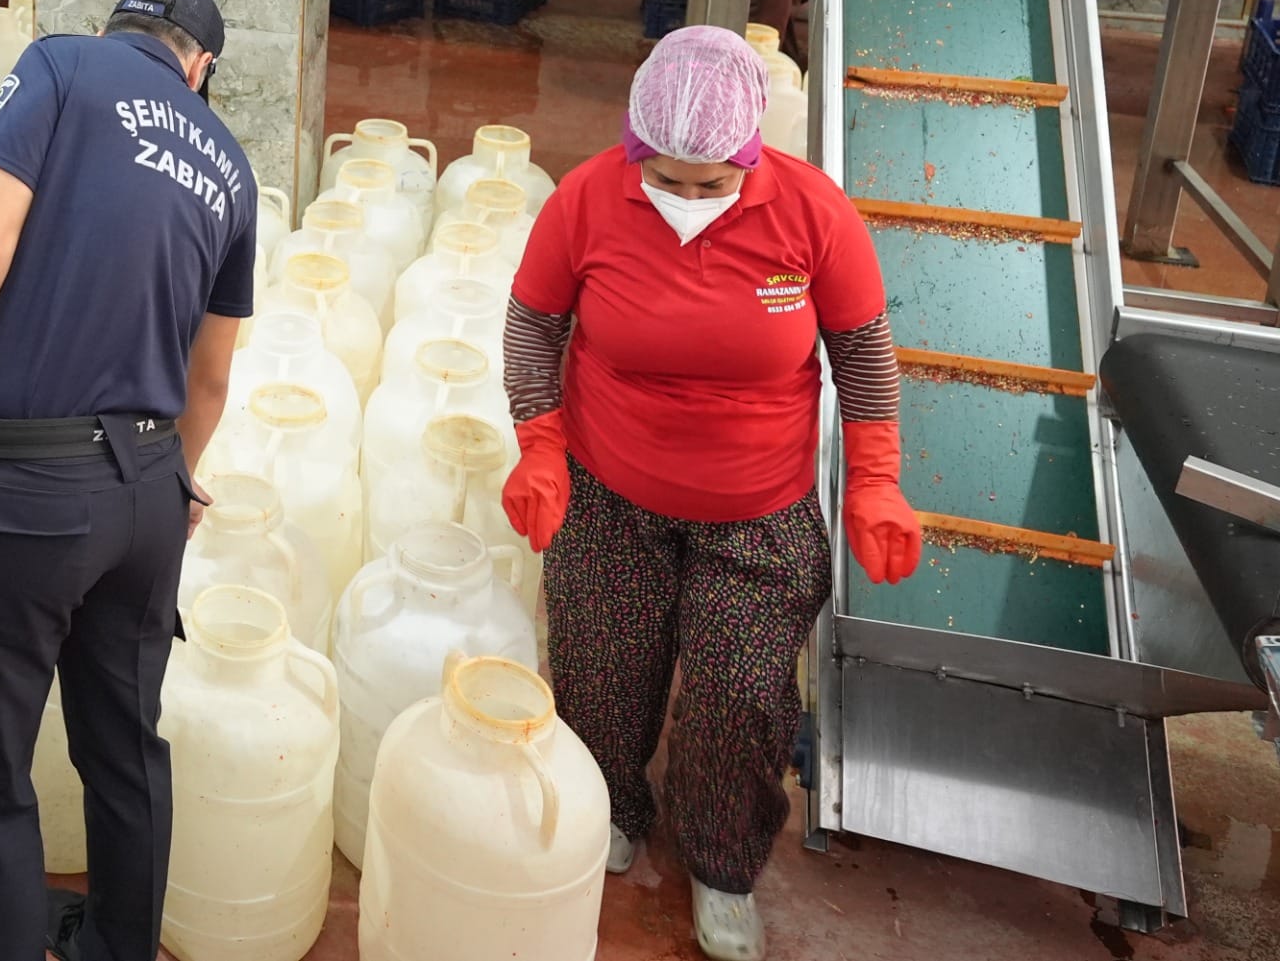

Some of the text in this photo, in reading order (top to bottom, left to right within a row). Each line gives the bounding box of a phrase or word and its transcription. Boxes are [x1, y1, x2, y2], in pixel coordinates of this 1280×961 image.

[128, 0, 154, 12] ZABITA
[115, 98, 242, 204] ŞEHİTKAMİL
[134, 139, 227, 221] ZABITA
[93, 418, 156, 441] ZTA
